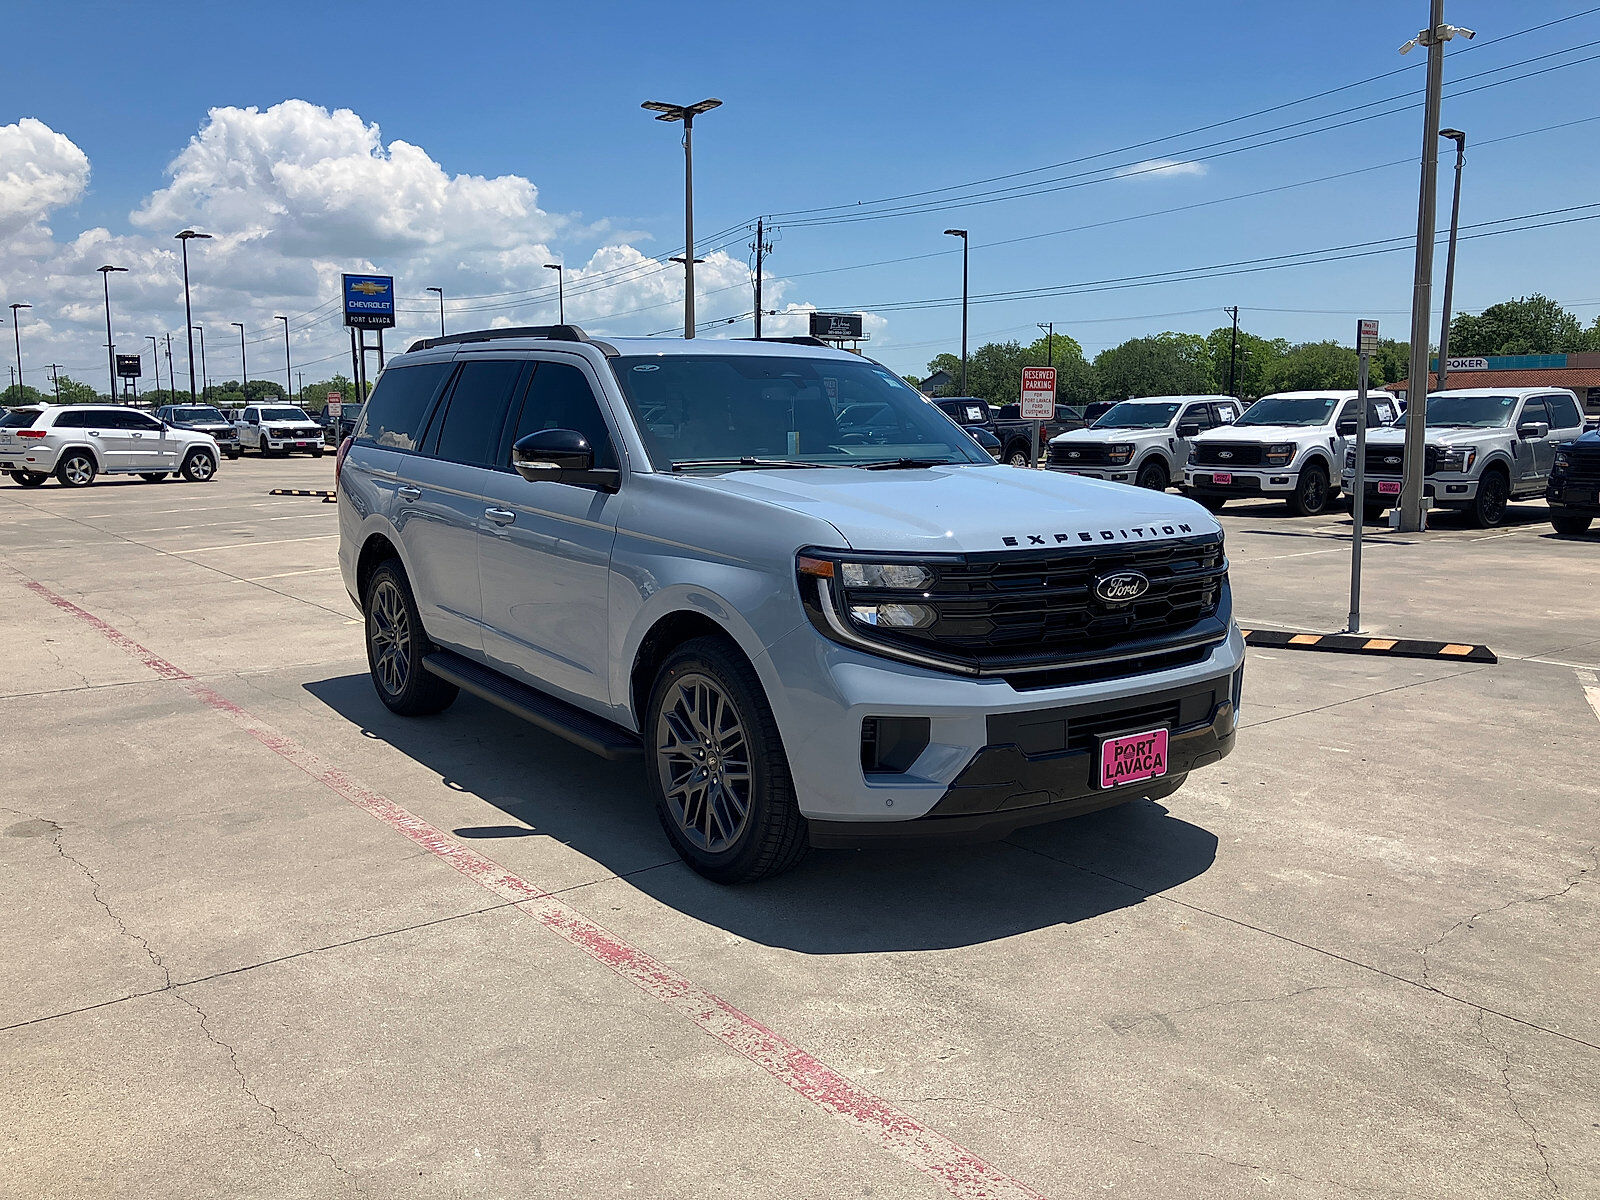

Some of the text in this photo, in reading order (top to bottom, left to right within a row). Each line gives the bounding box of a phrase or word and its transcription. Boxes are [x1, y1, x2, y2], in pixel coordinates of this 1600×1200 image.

[349, 301, 390, 309] CHEVROLET
[1024, 370, 1054, 379] RESERVED
[1025, 380, 1052, 389] PARKING
[1001, 523, 1192, 547] EXPEDITION
[1107, 577, 1139, 597] Ford
[1114, 739, 1156, 761] PORT
[1105, 752, 1163, 779] LAVACA
